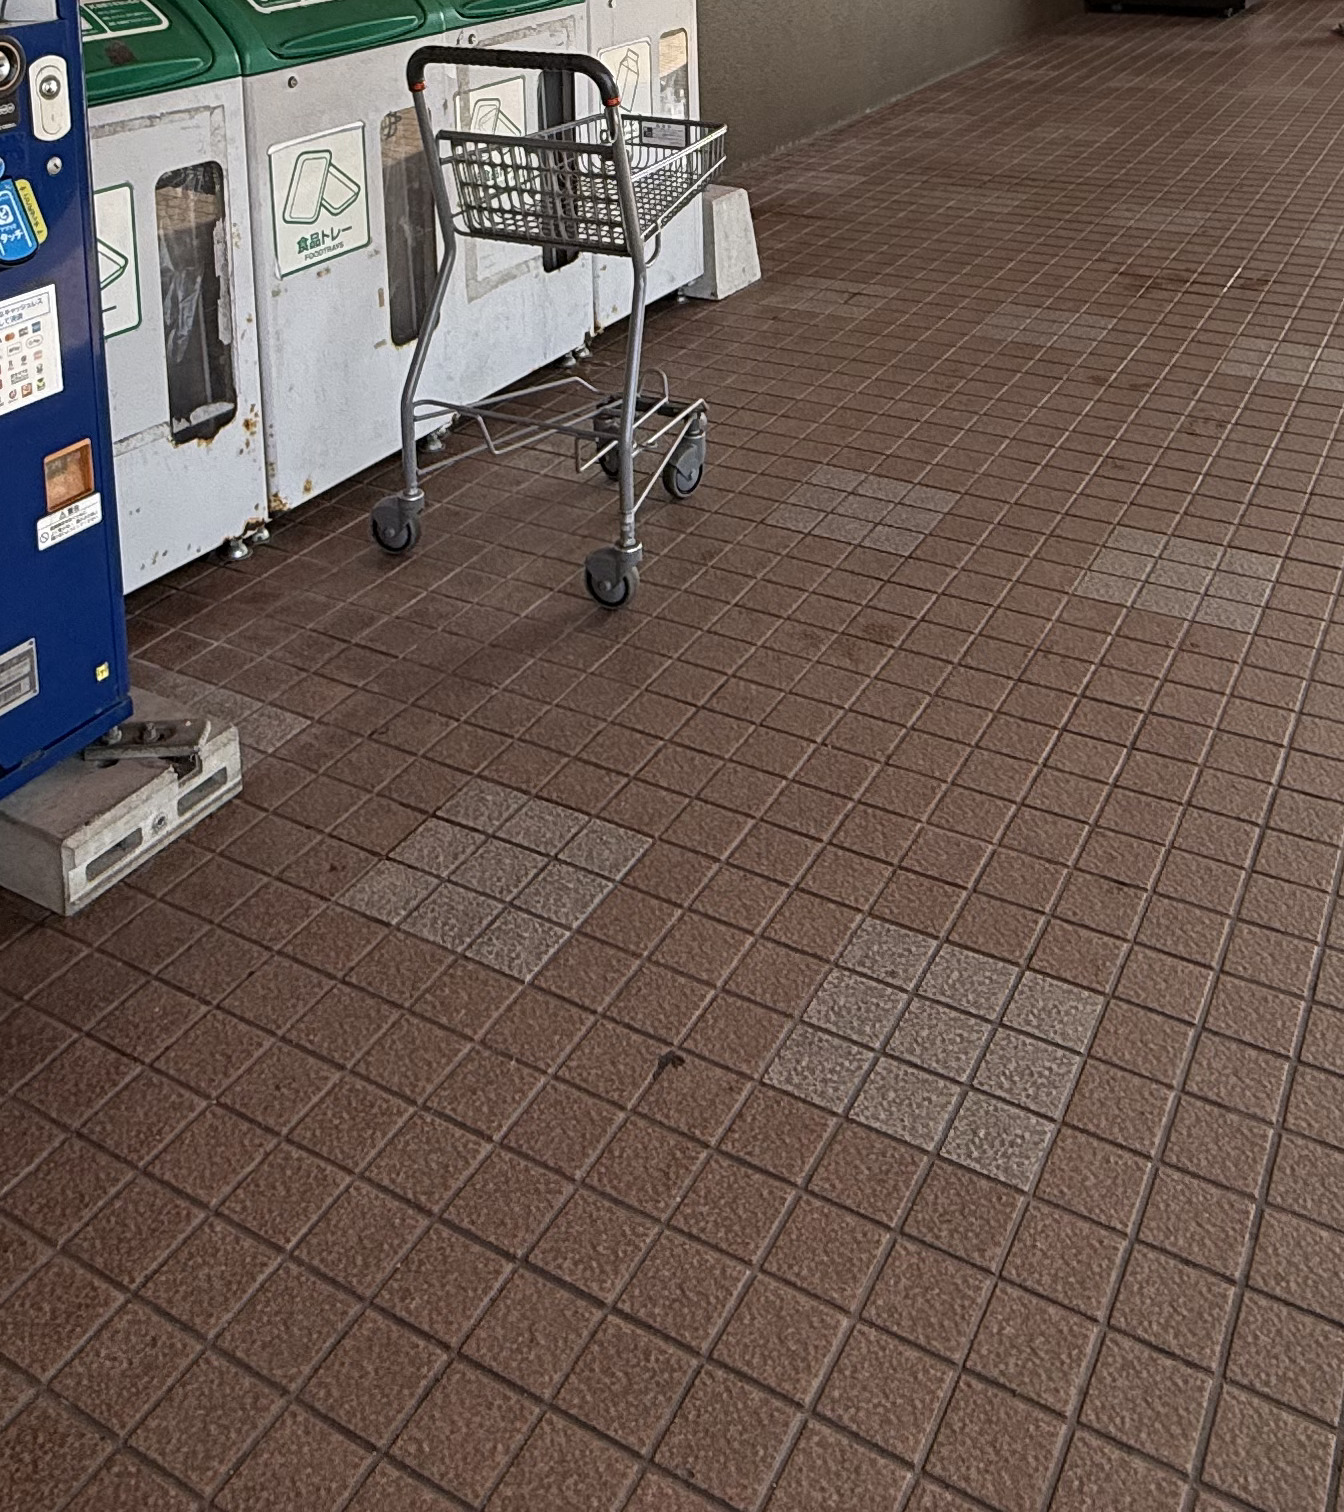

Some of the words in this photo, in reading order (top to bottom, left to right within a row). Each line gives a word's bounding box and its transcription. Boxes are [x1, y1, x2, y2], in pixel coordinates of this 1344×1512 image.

[297, 226, 353, 254] 食品トレー
